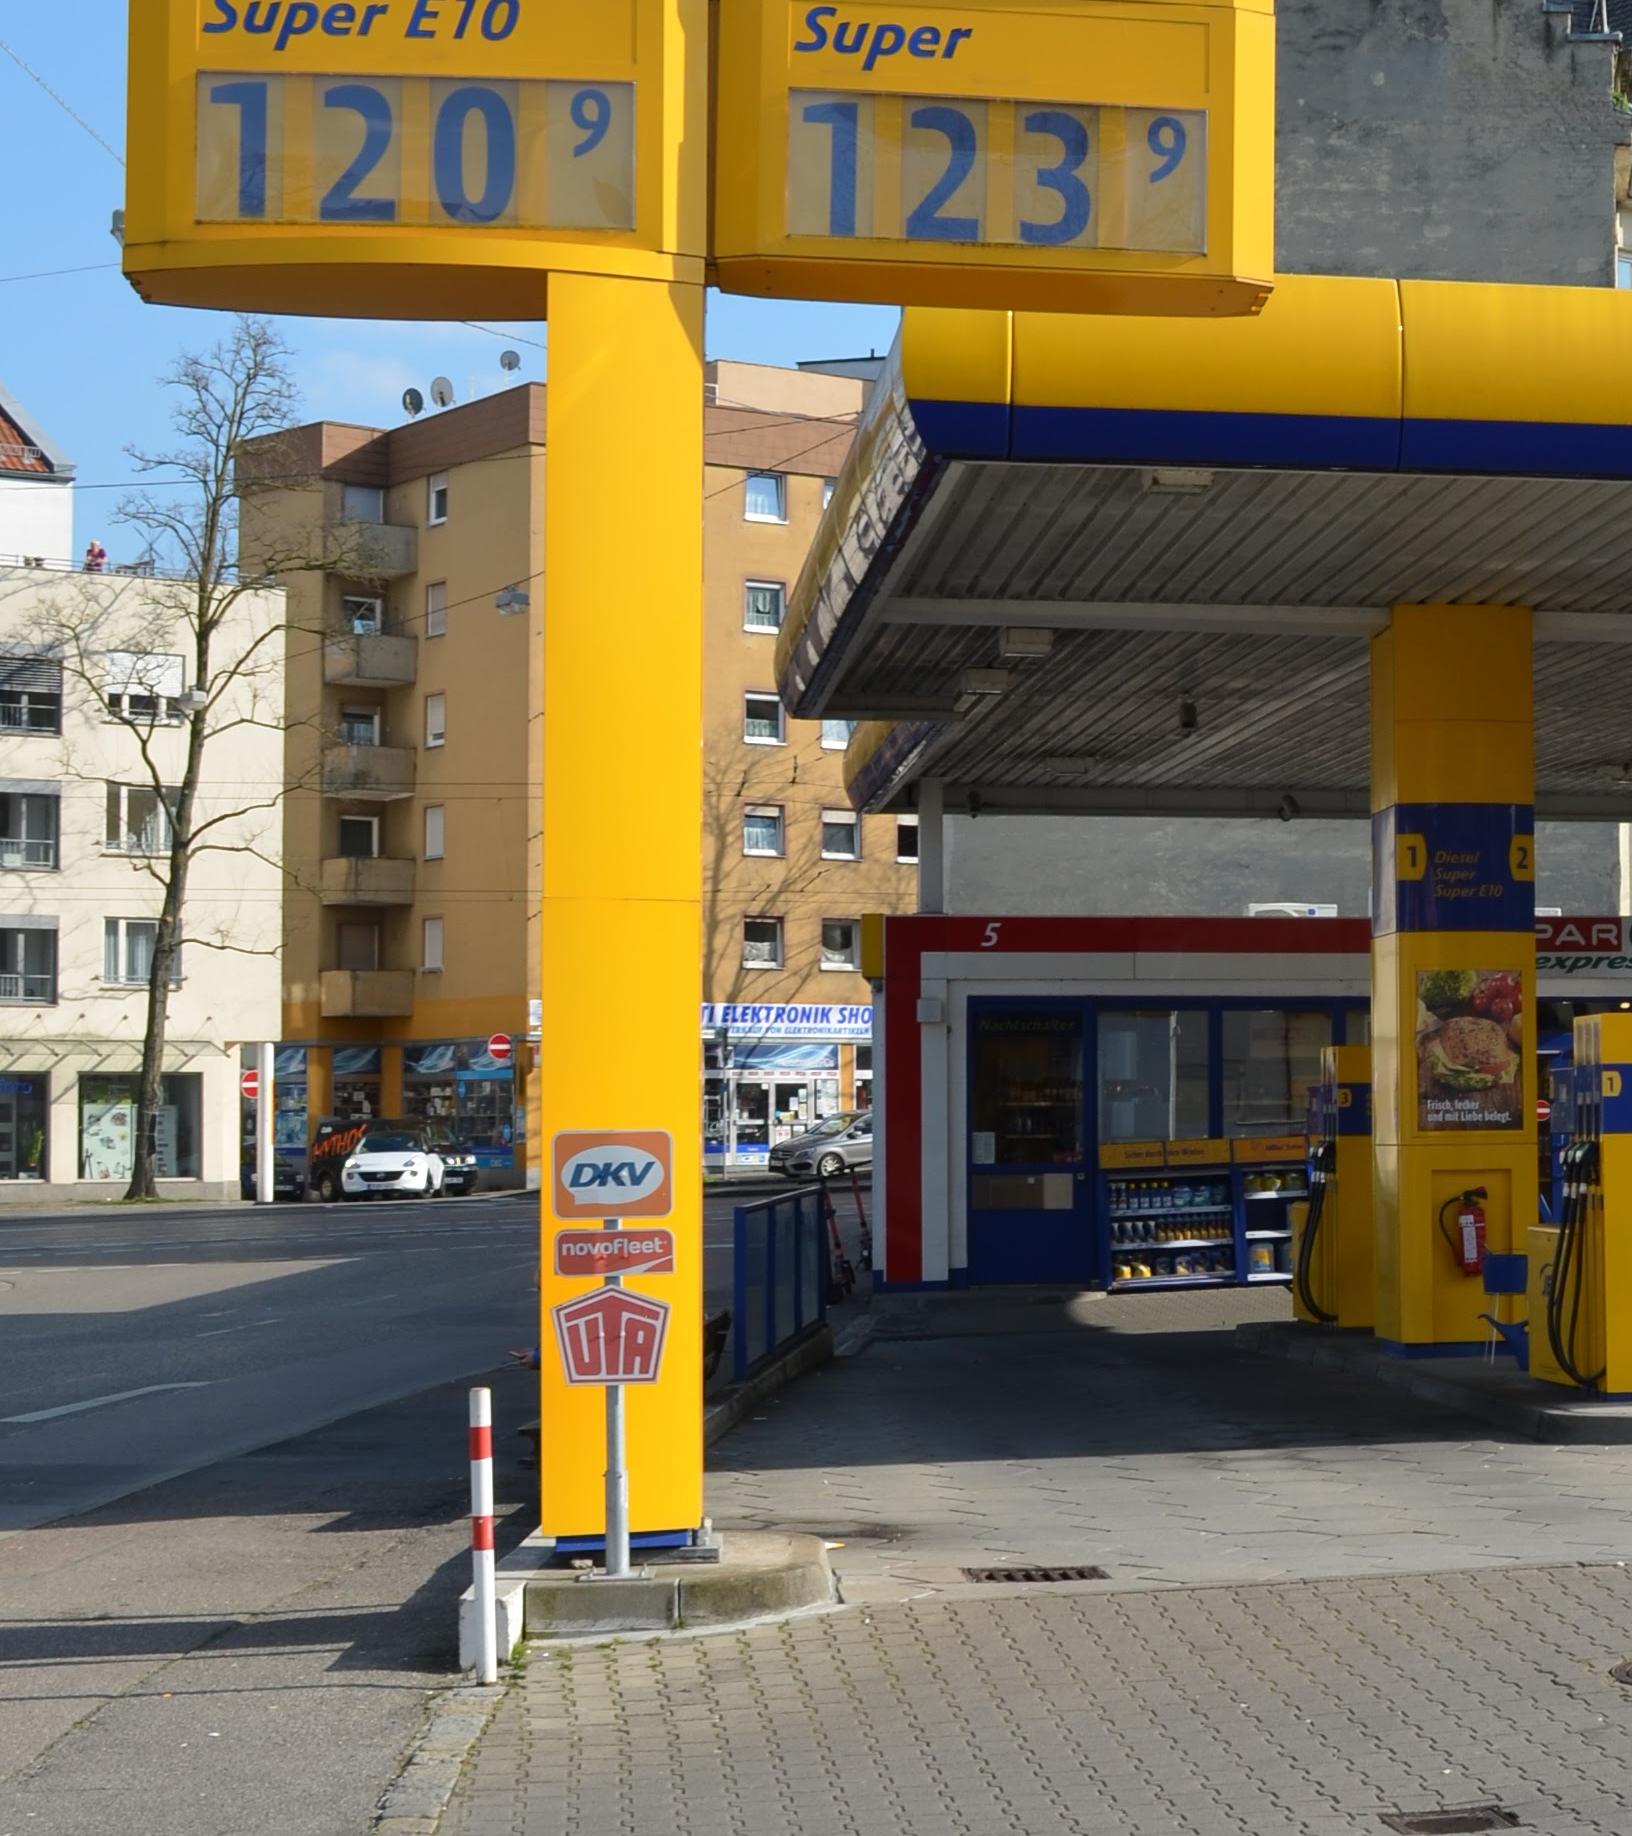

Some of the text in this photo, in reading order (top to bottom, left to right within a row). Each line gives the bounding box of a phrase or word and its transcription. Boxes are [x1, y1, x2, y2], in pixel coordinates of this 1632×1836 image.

[201, 0, 520, 51] Super E10
[794, 7, 972, 71] Super
[1407, 846, 1417, 868] 1
[1434, 850, 1480, 864] Diesel
[1517, 846, 1528, 869] 2
[1434, 868, 1476, 883] Super
[1434, 884, 1503, 901] Super E10
[981, 922, 1002, 947] 5
[721, 1005, 831, 1024] ELEKTRONIK
[1607, 1077, 1614, 1092] 1
[1427, 1099, 1479, 1111] Frisch, lecker
[1427, 1111, 1443, 1122] und
[1444, 1111, 1459, 1122] mit
[1461, 1110, 1483, 1122] Liebe
[569, 1160, 656, 1188] DKV
[561, 1236, 664, 1257] novofleet
[564, 1294, 660, 1377] UTA
